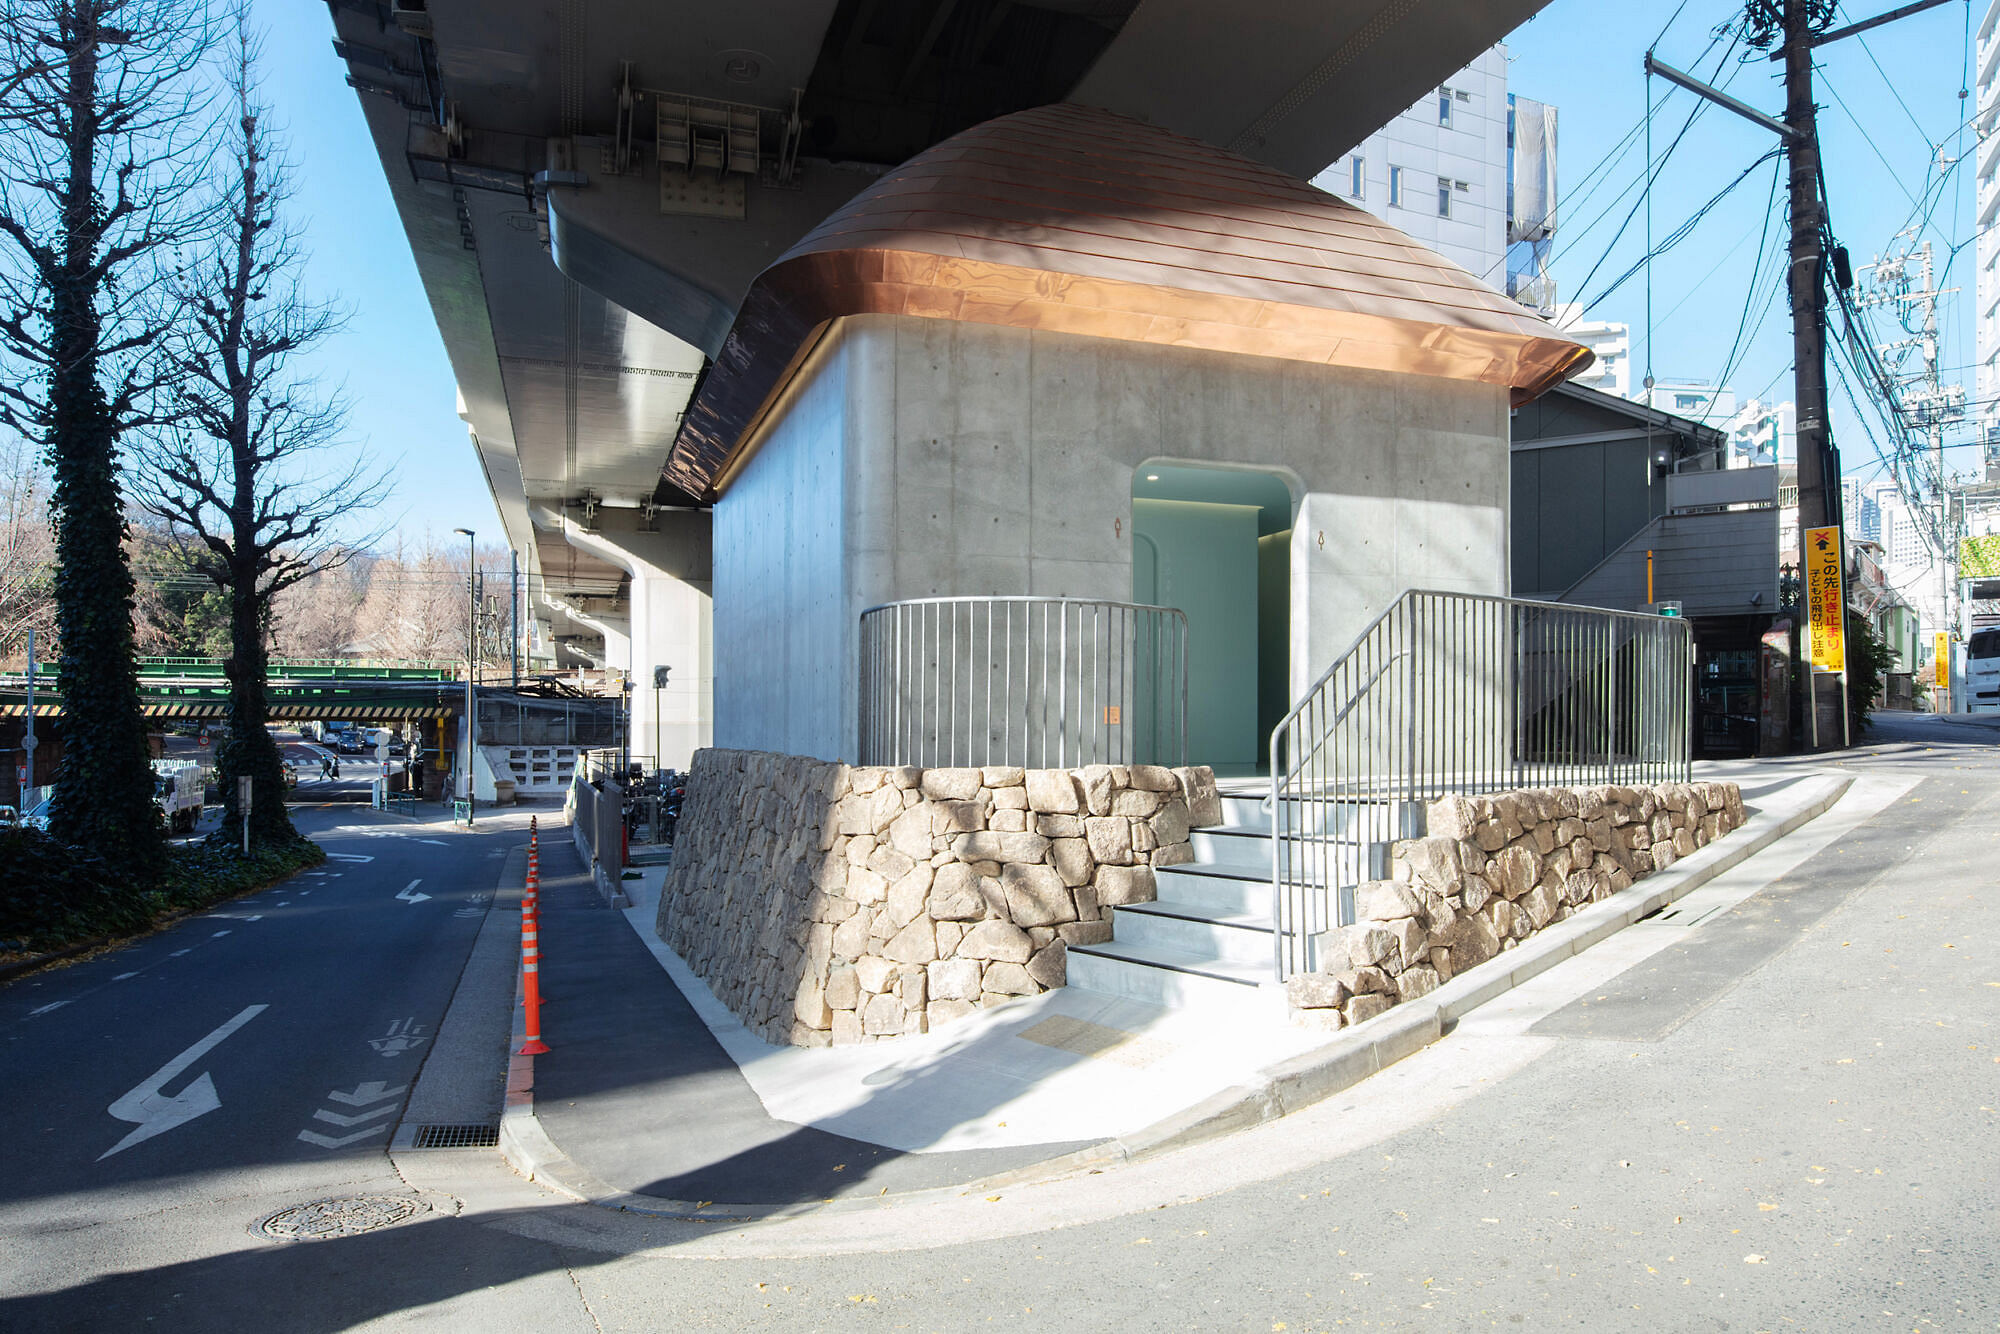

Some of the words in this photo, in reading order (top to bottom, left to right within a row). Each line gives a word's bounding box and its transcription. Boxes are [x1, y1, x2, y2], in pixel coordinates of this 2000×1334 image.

[1810, 569, 1824, 657] 子どもの飛び出し注意
[1823, 552, 1840, 651] この先行き止まり
